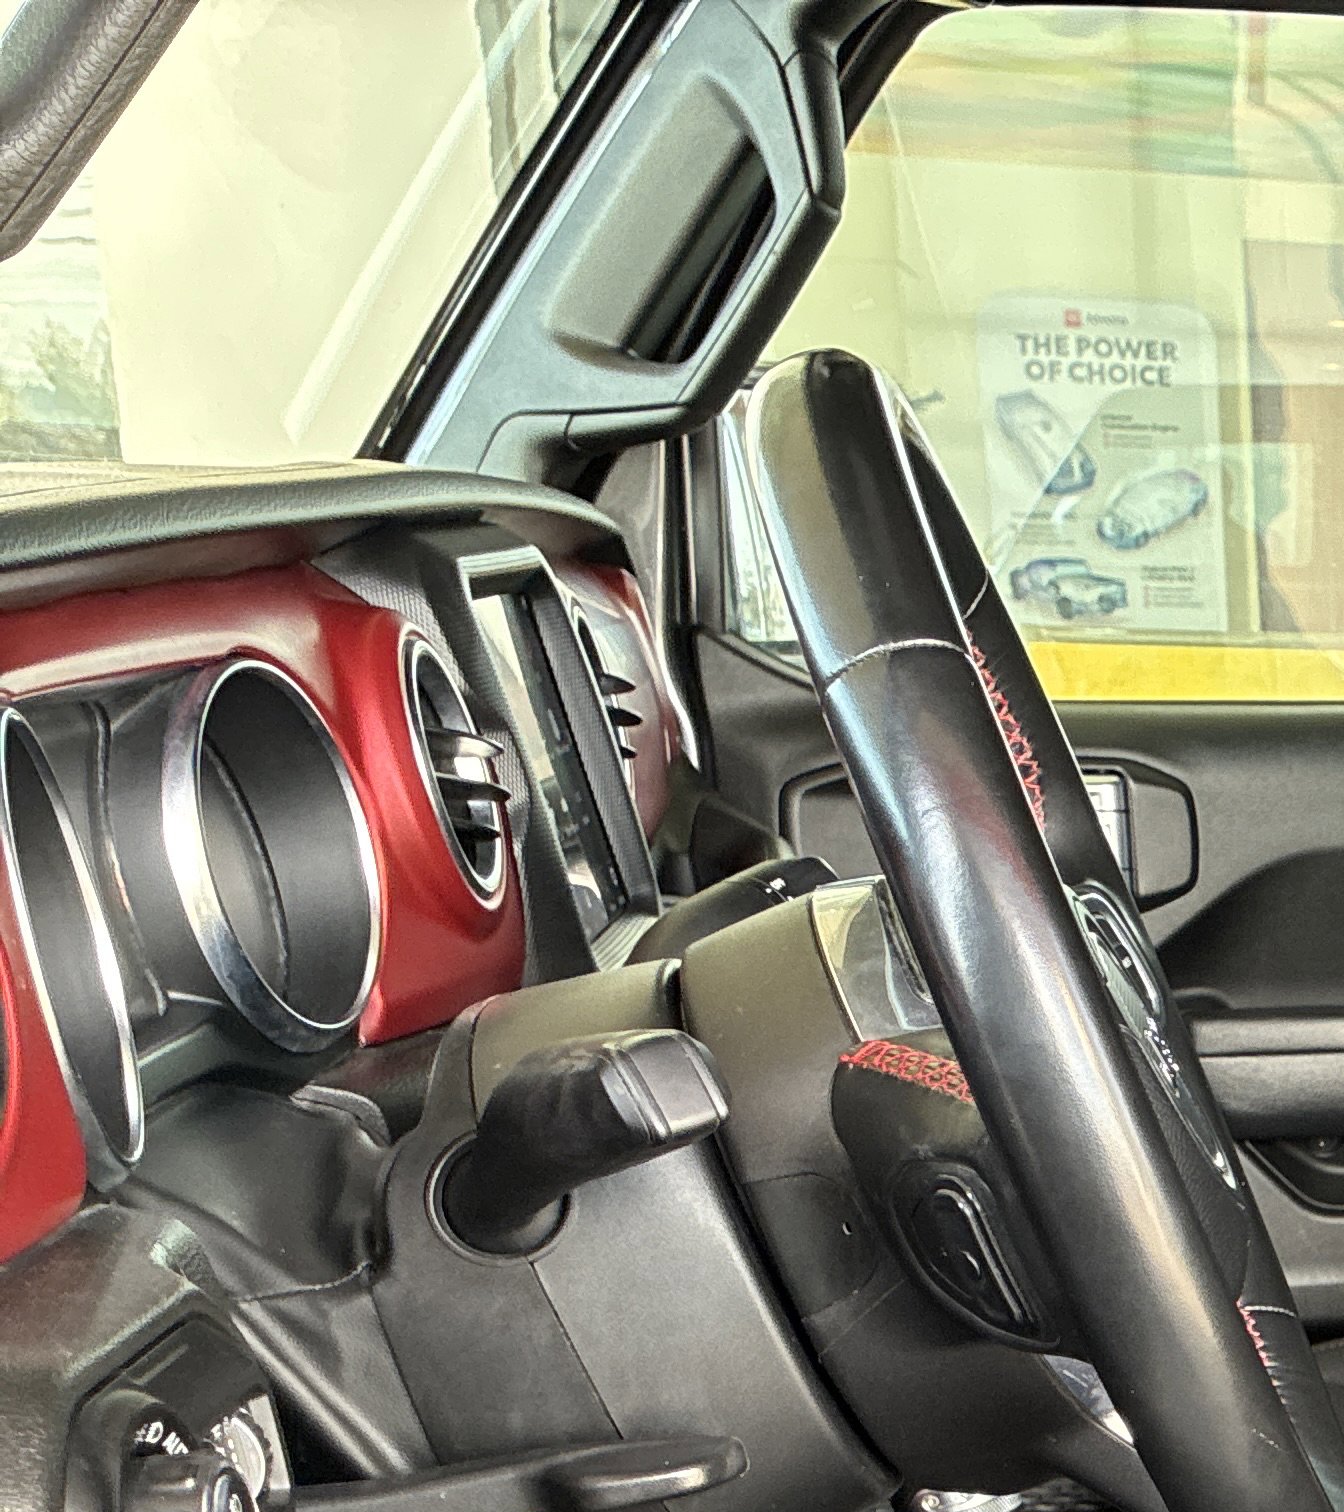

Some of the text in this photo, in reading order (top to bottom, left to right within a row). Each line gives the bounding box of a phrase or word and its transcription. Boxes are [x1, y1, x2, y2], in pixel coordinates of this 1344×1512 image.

[1017, 333, 1179, 363] THE POWER
[1025, 360, 1172, 388] OF CHOICE
